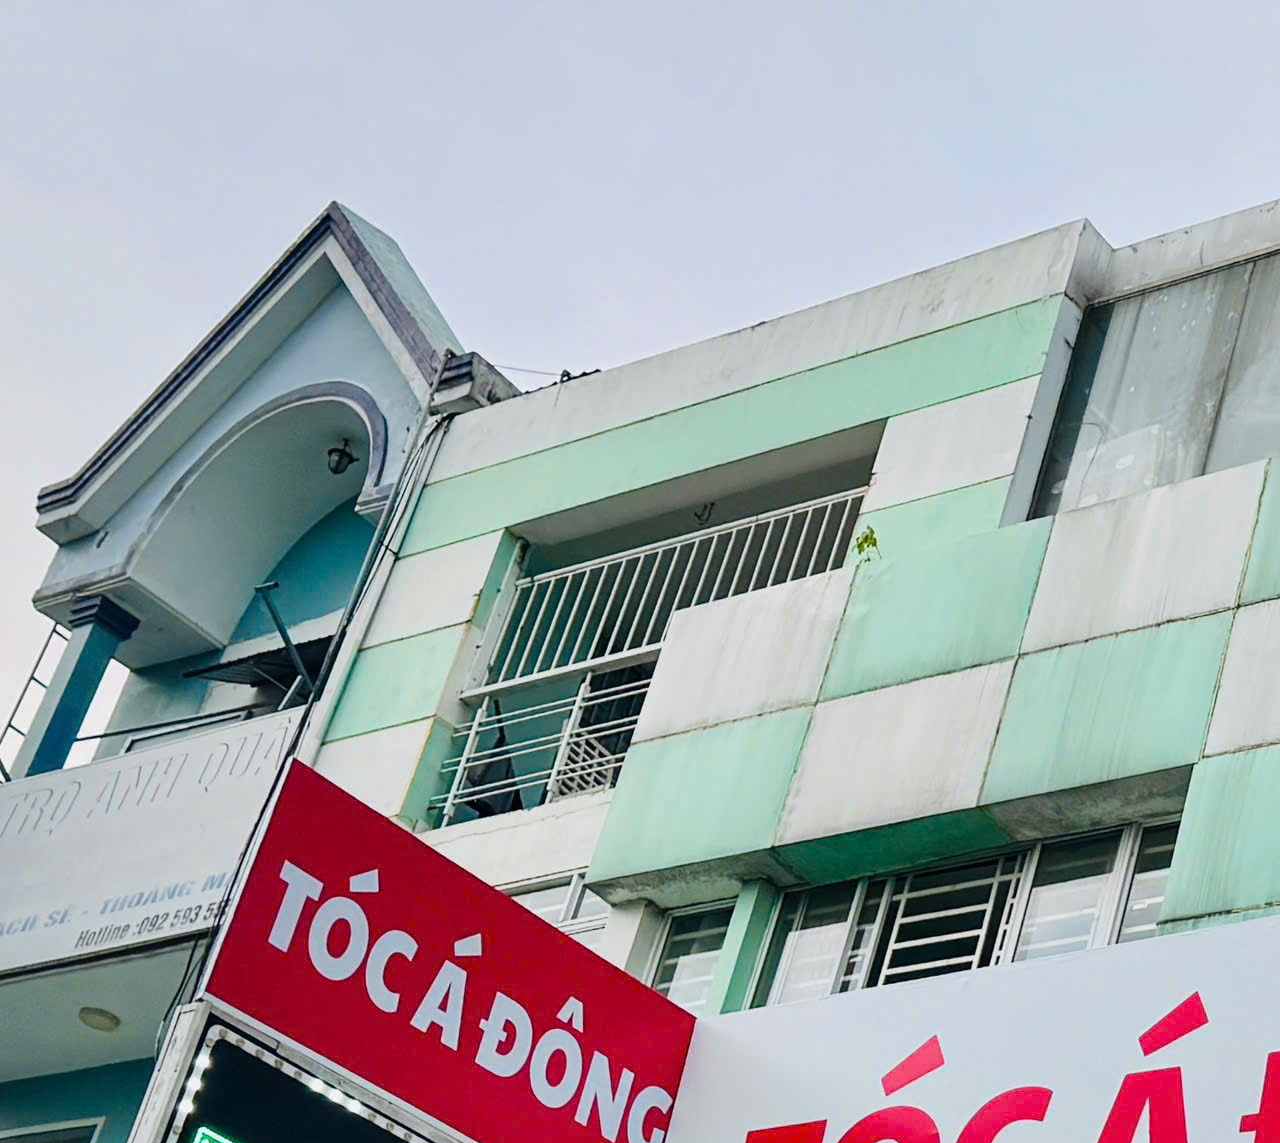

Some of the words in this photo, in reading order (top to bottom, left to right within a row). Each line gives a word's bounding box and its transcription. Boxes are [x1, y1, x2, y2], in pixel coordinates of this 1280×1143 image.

[74, 921, 131, 950] Hotline
[267, 860, 418, 1014] TÓC
[410, 932, 483, 1051] Á
